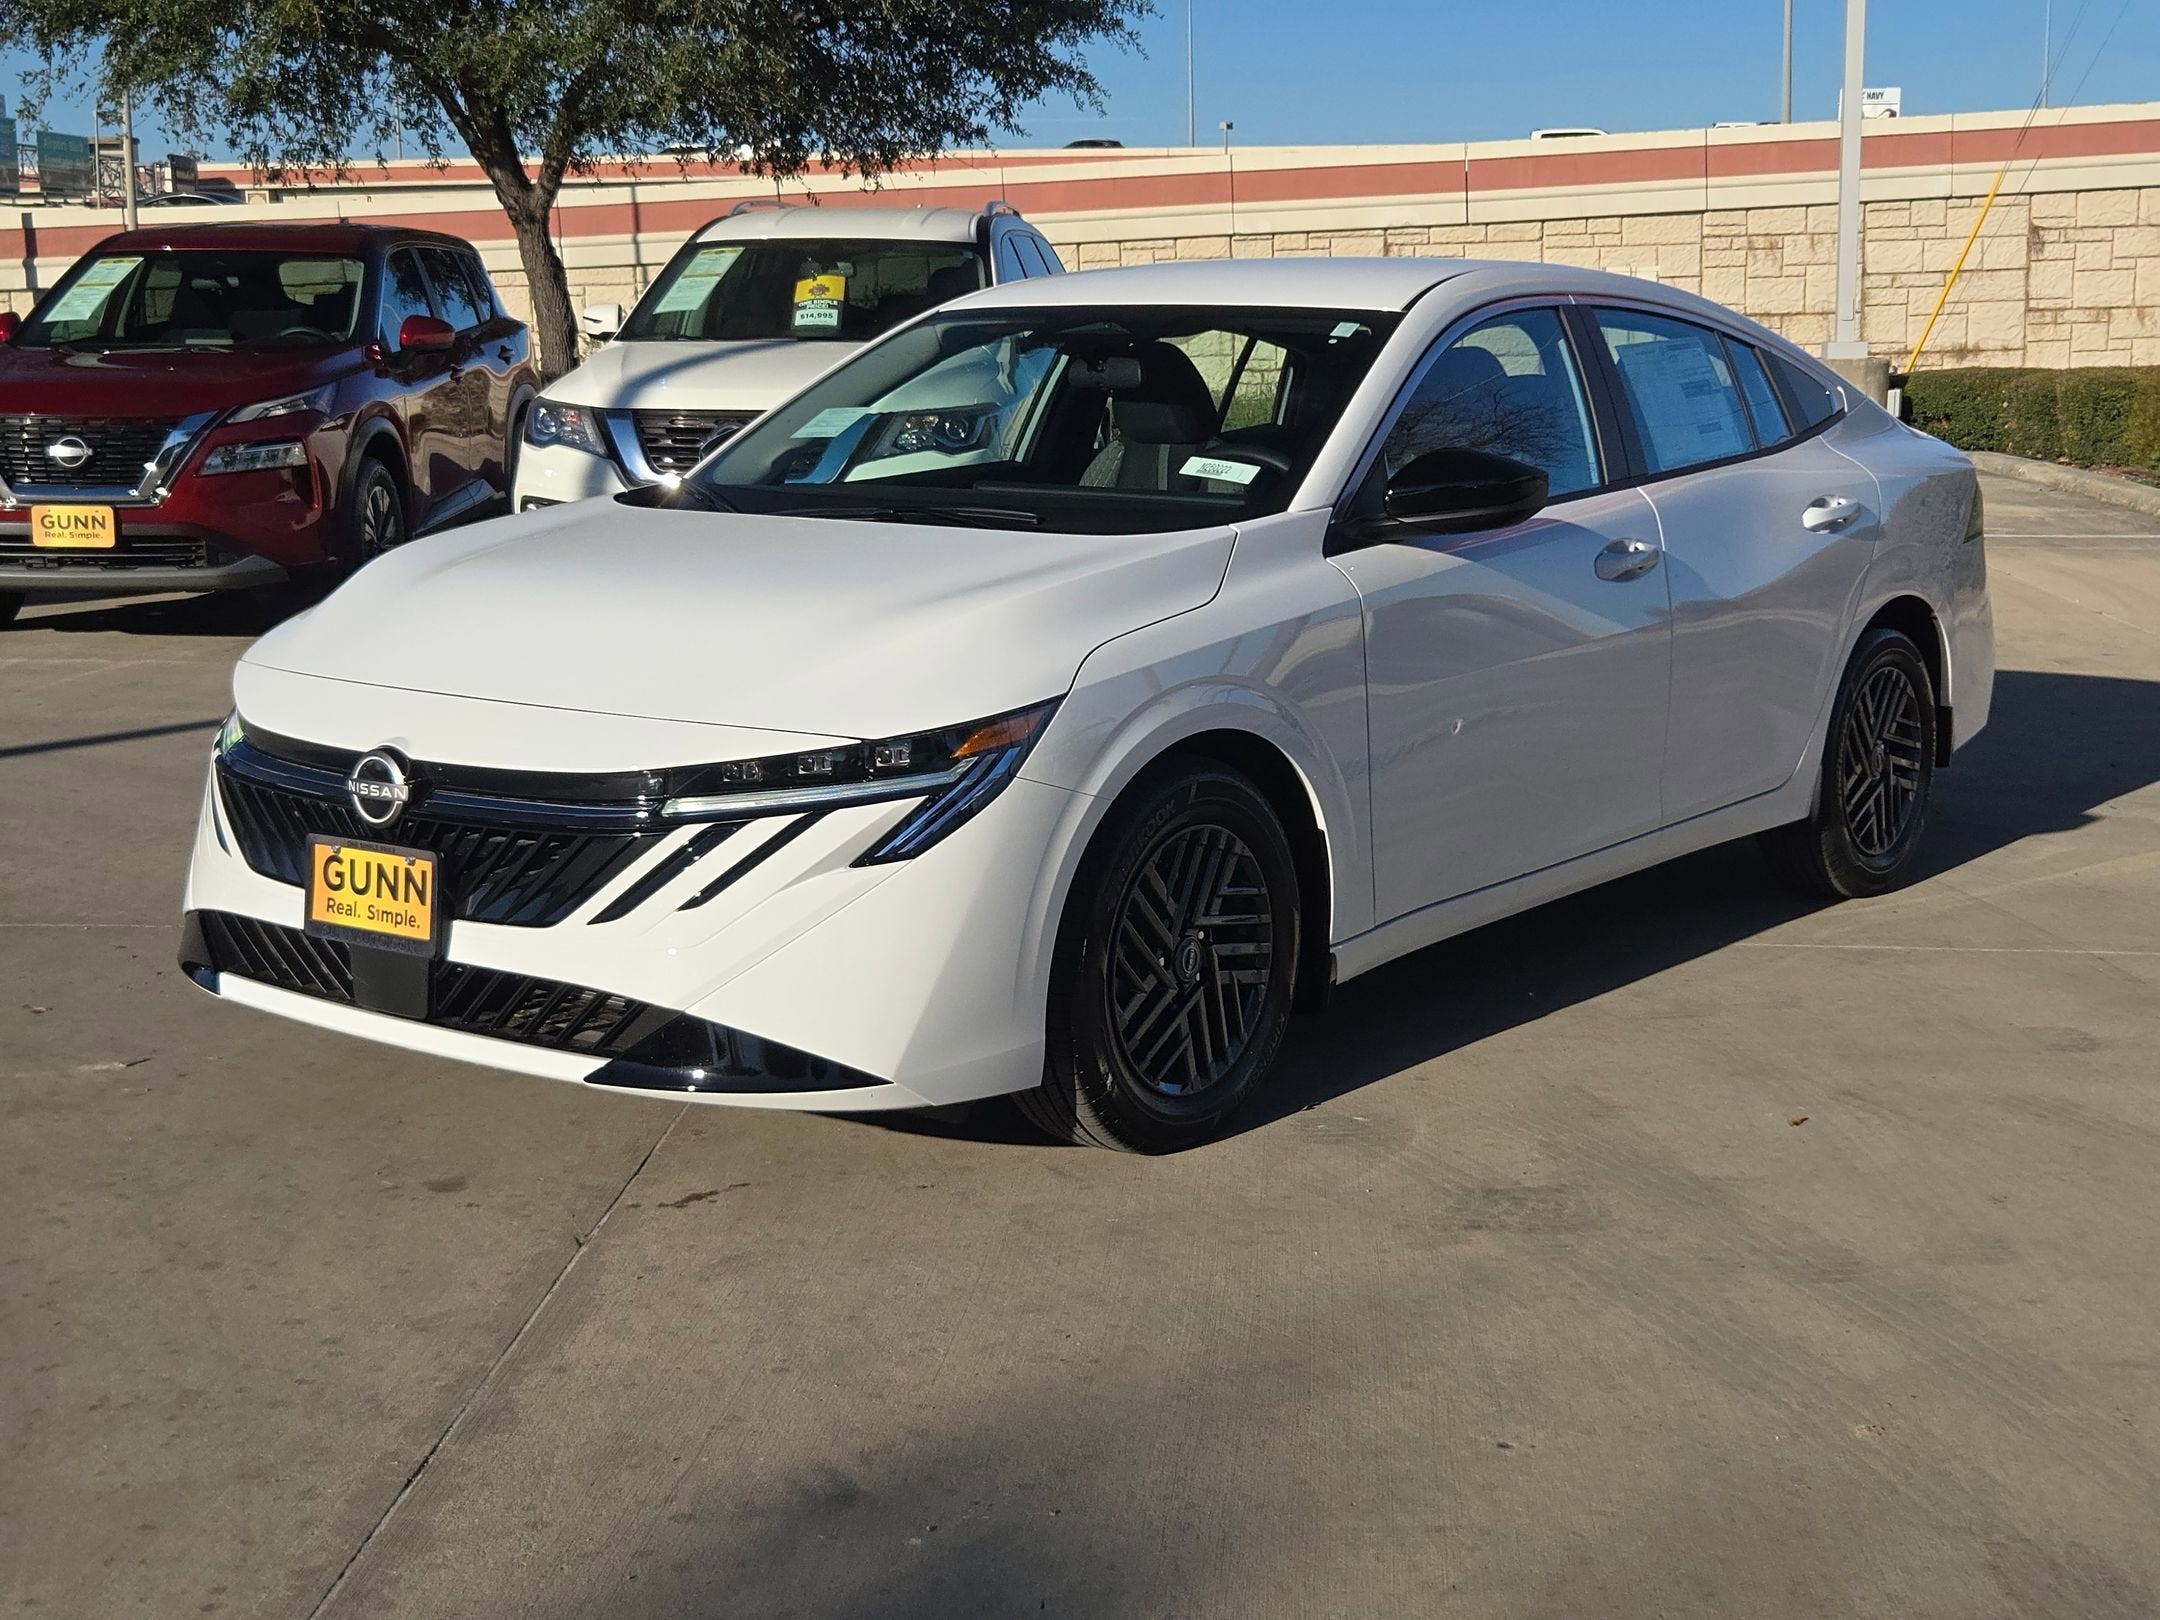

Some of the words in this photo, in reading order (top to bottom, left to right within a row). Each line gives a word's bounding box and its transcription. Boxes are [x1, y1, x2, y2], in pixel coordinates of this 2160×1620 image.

[1866, 90, 1885, 100] NAVY
[800, 312, 834, 320] $14,995
[40, 514, 106, 530] GUNN
[348, 779, 406, 799] NISSAN
[323, 854, 428, 907] GUNN
[326, 897, 361, 918] Real.
